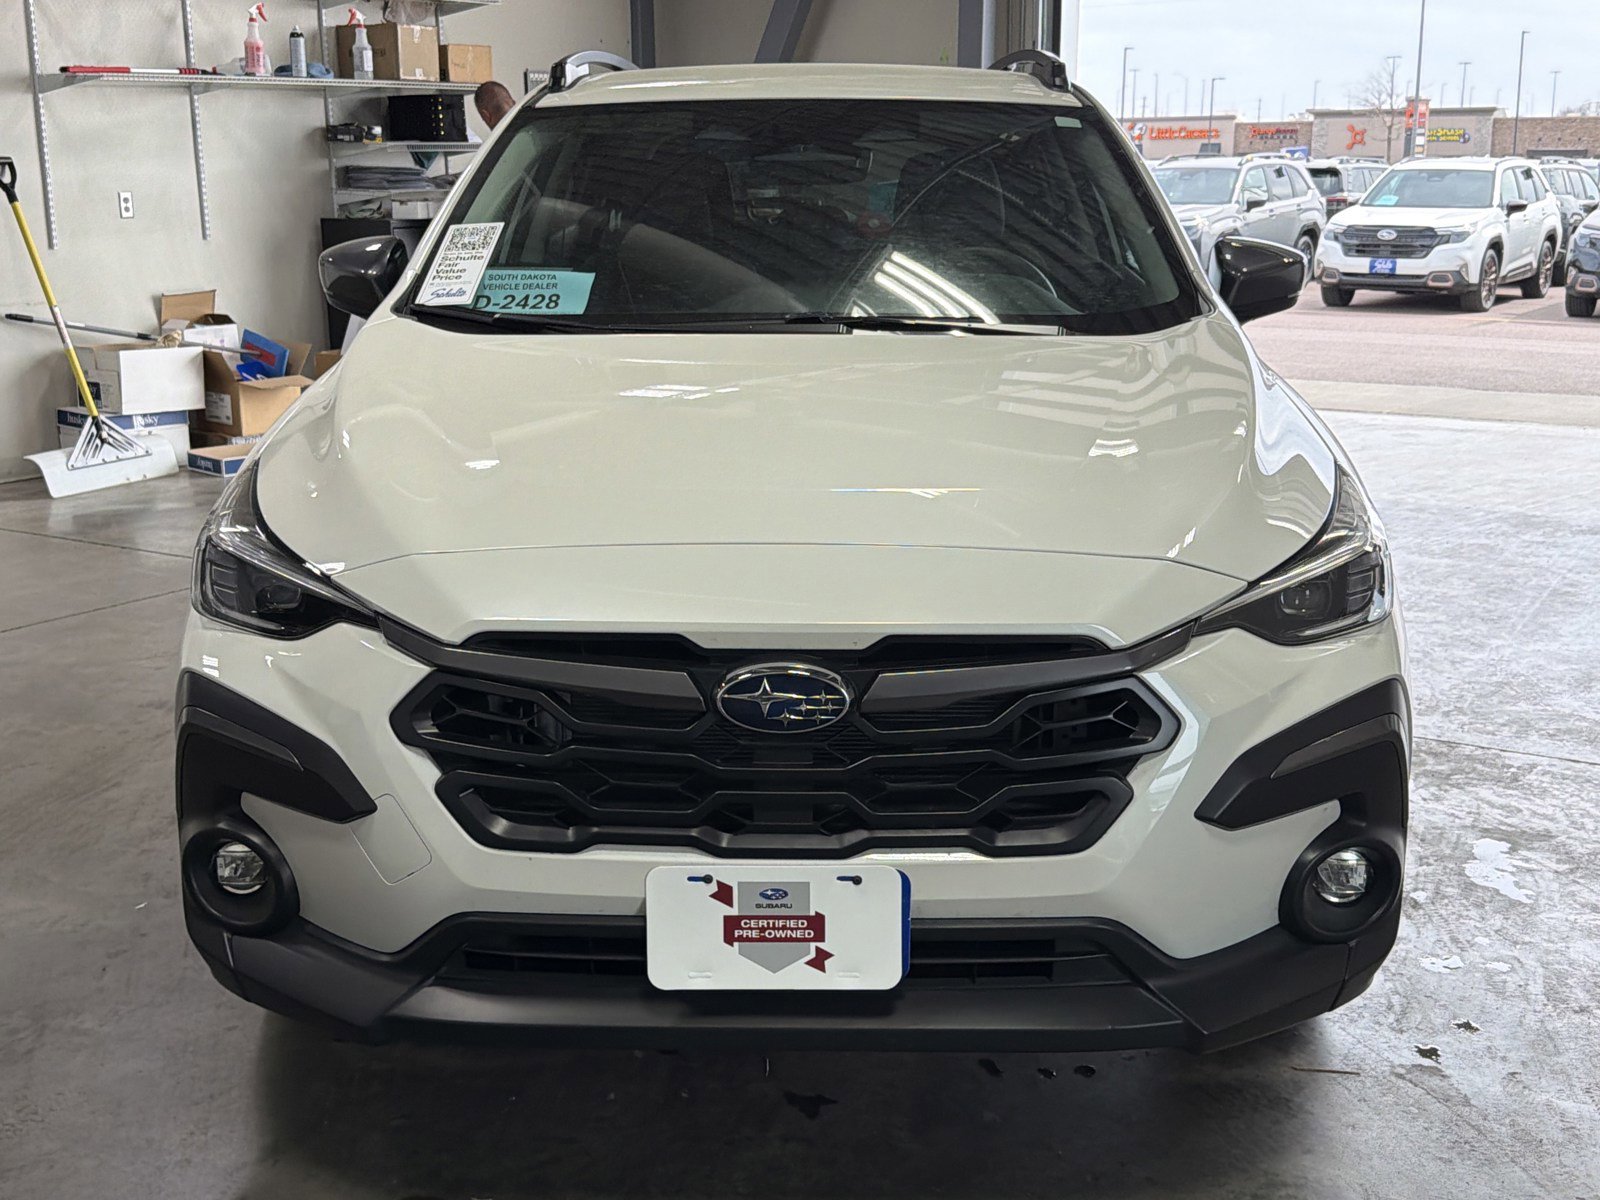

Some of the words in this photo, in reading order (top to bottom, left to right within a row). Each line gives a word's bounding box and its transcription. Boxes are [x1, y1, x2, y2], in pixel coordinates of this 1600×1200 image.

[1148, 127, 1178, 140] Little
[441, 254, 485, 262] Schulte
[435, 267, 467, 275] Value
[487, 273, 519, 281] SOUTH
[520, 273, 557, 281] DAKOTA
[483, 283, 520, 291] VEHICLE
[522, 282, 558, 290] DEALER
[475, 293, 561, 310] D-2428
[740, 919, 808, 929] CERTIFIED
[734, 929, 814, 939] PRE-OWNED
